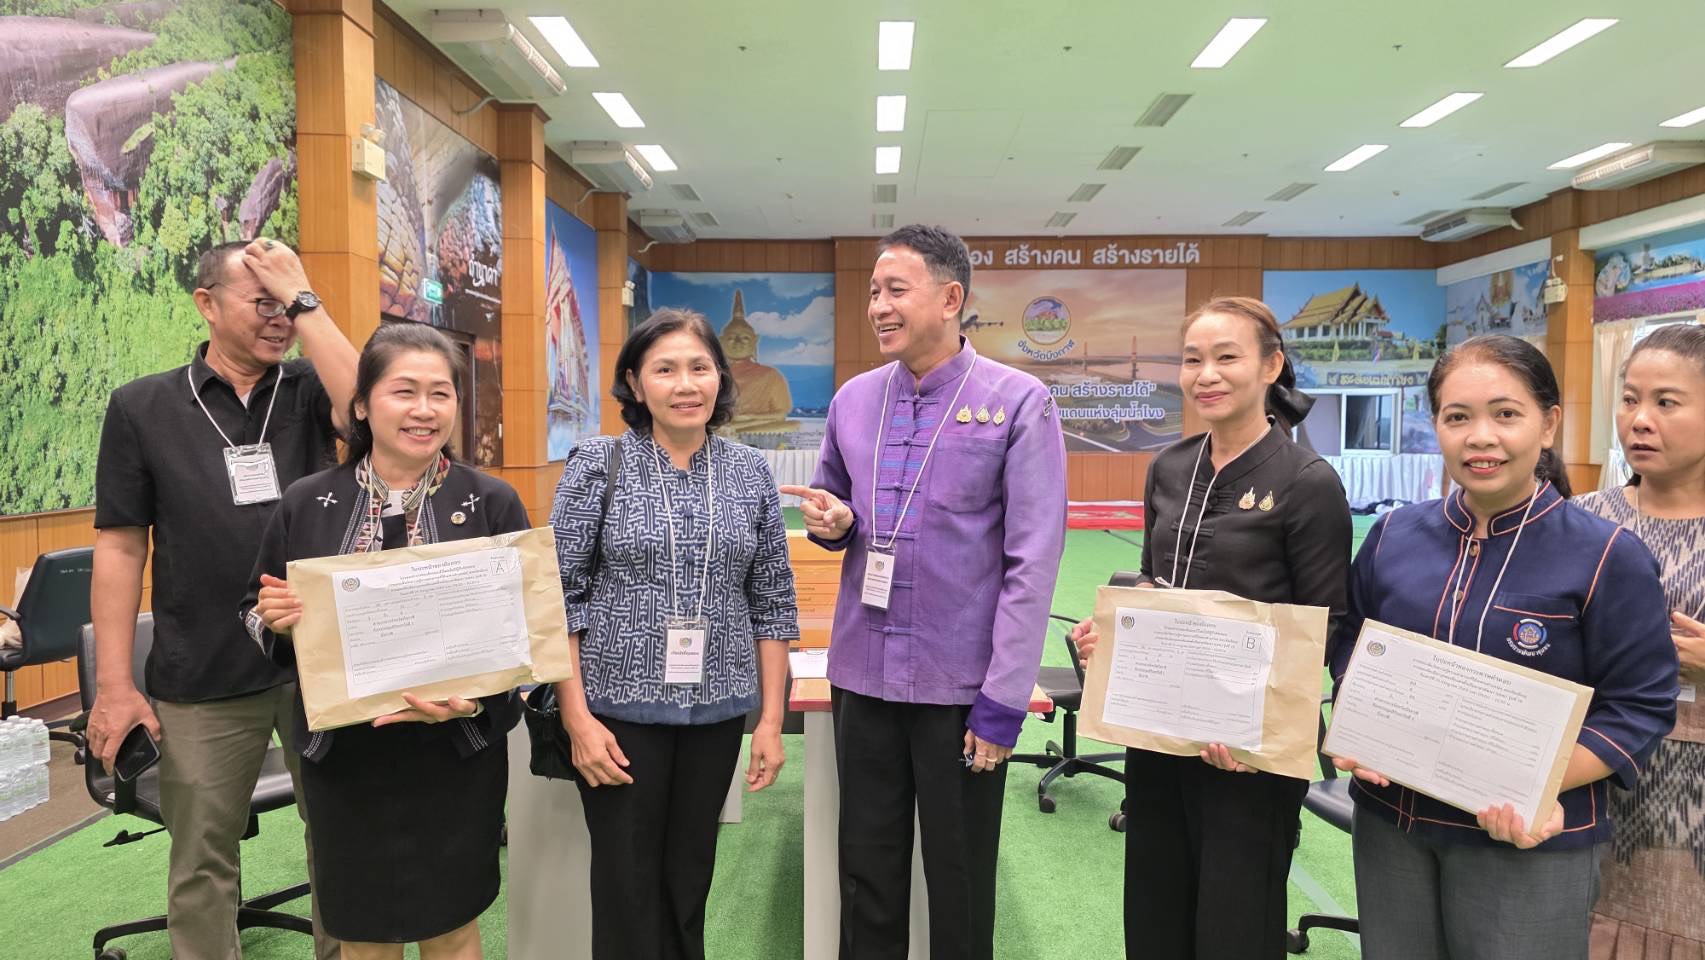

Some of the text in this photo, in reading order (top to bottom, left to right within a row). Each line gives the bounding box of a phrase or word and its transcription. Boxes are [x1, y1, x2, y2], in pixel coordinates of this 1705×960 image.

[1004, 243, 1081, 266] สร้างคน
[1092, 242, 1200, 265] สร้างรายได้
[1017, 338, 1075, 360] จังหวัดบึงกาฬ
[1071, 380, 1157, 397] สร้างรายได้”
[1059, 403, 1165, 423] แดนแห่งลุ่มน้ำโขง
[495, 561, 505, 573] A
[1246, 637, 1257, 650] B
